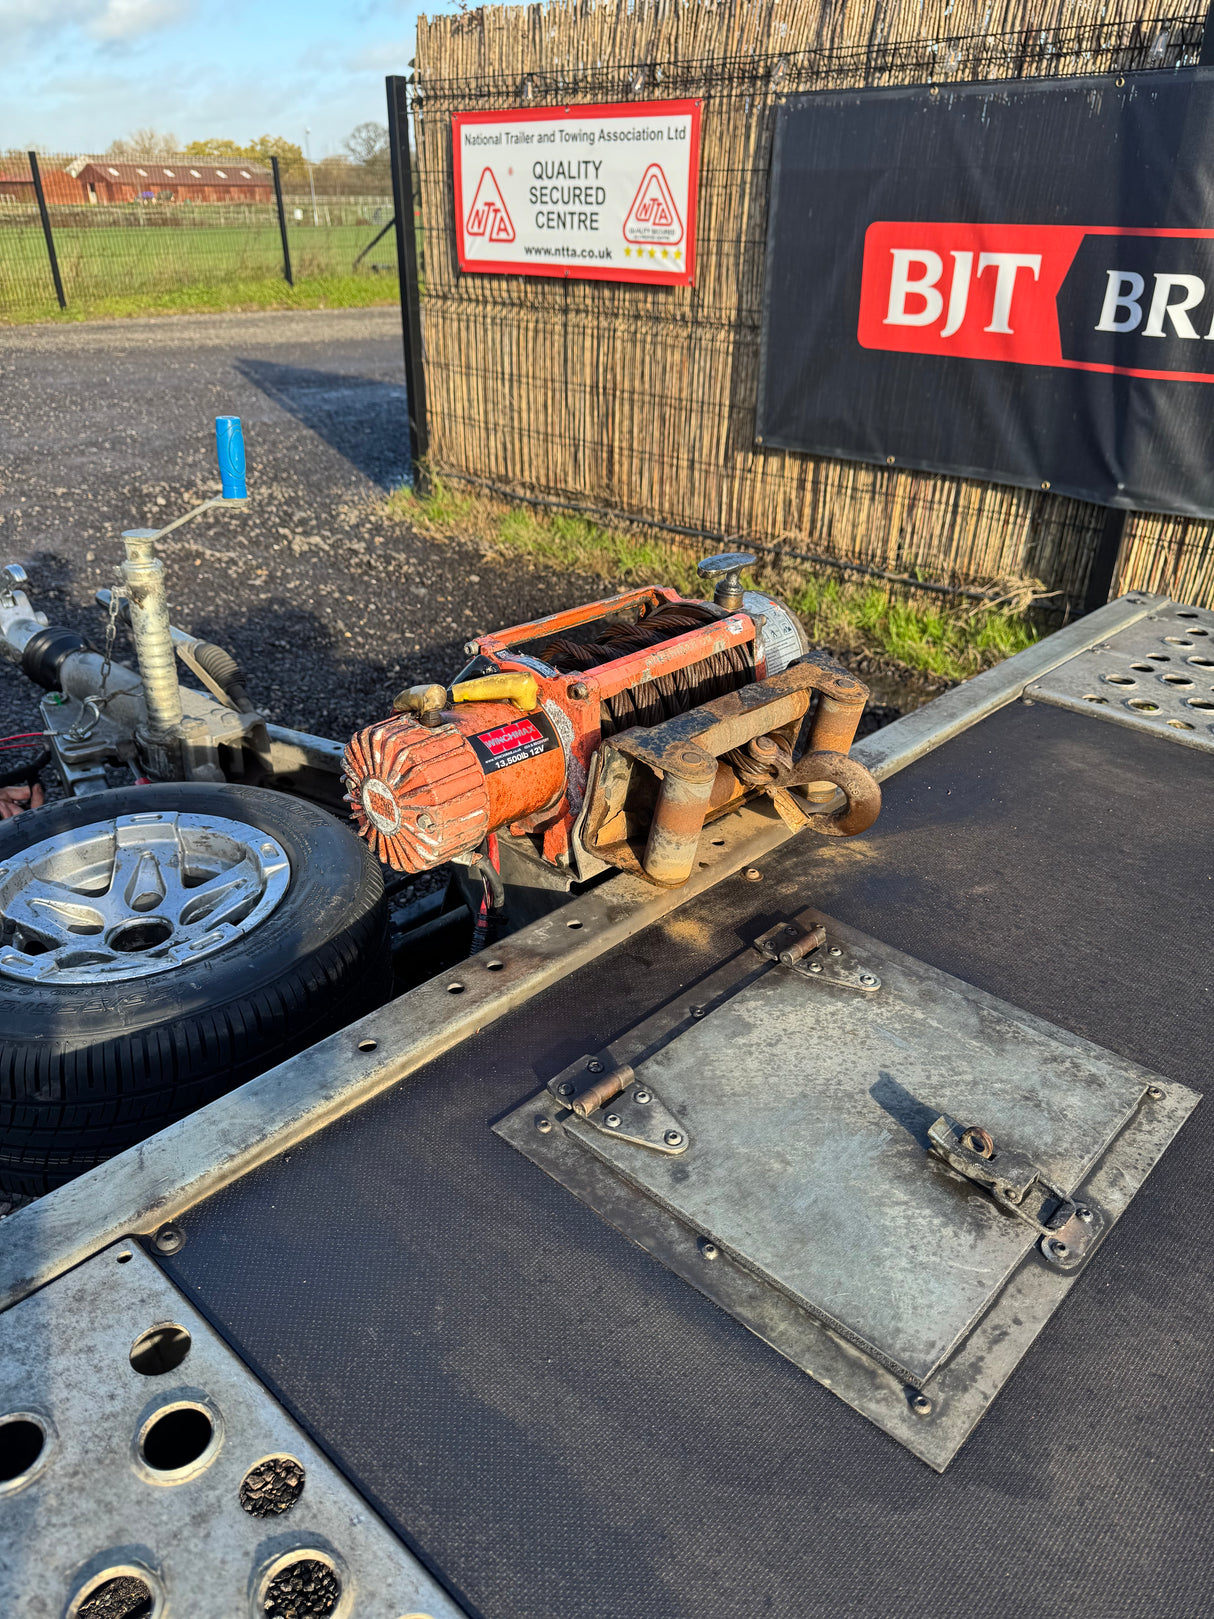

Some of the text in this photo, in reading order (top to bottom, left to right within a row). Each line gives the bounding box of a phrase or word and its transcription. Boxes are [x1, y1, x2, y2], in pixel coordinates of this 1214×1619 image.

[464, 126, 686, 146] National Trailer and Towing Association Ltd
[532, 160, 603, 180] QUALITY
[529, 186, 606, 205] SECURED
[535, 211, 600, 231] CENTRE
[523, 244, 613, 259] www.ntta.co.uk
[882, 248, 1214, 340] BJT BR
[484, 725, 537, 748] WINCHMAX
[495, 744, 545, 769] 13,500lb 12V
